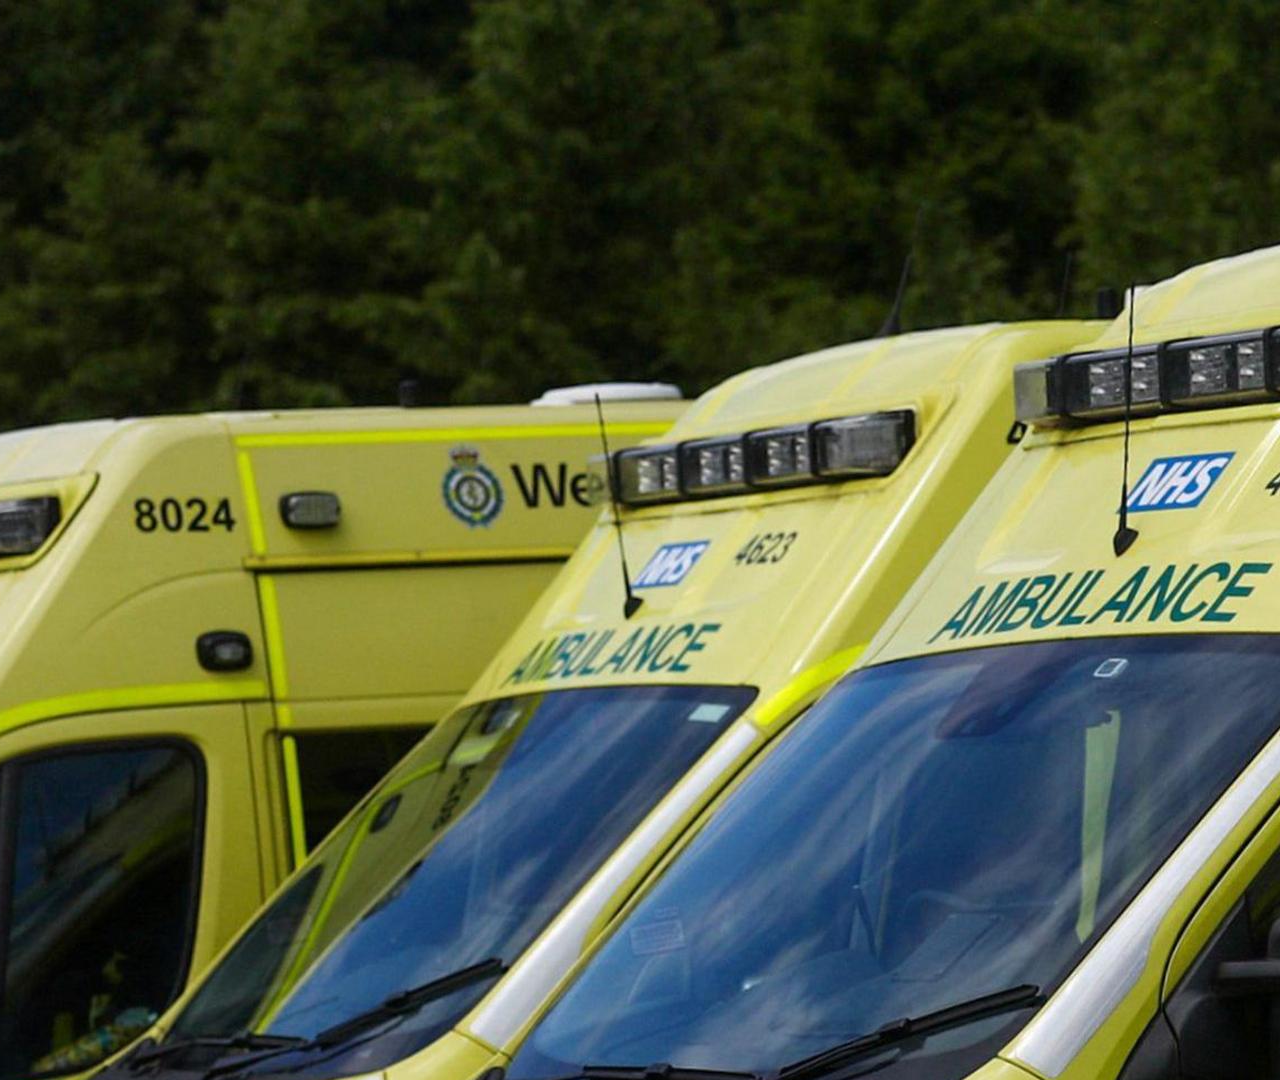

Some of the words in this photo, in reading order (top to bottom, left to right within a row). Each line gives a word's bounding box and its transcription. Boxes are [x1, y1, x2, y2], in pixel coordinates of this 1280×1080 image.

[1125, 457, 1227, 507] NHS
[135, 498, 235, 532] 8024
[639, 543, 708, 586] NHS
[734, 531, 798, 566] 4623
[928, 562, 1273, 644] AMBULANCE
[500, 623, 721, 688] AMBULANCE
